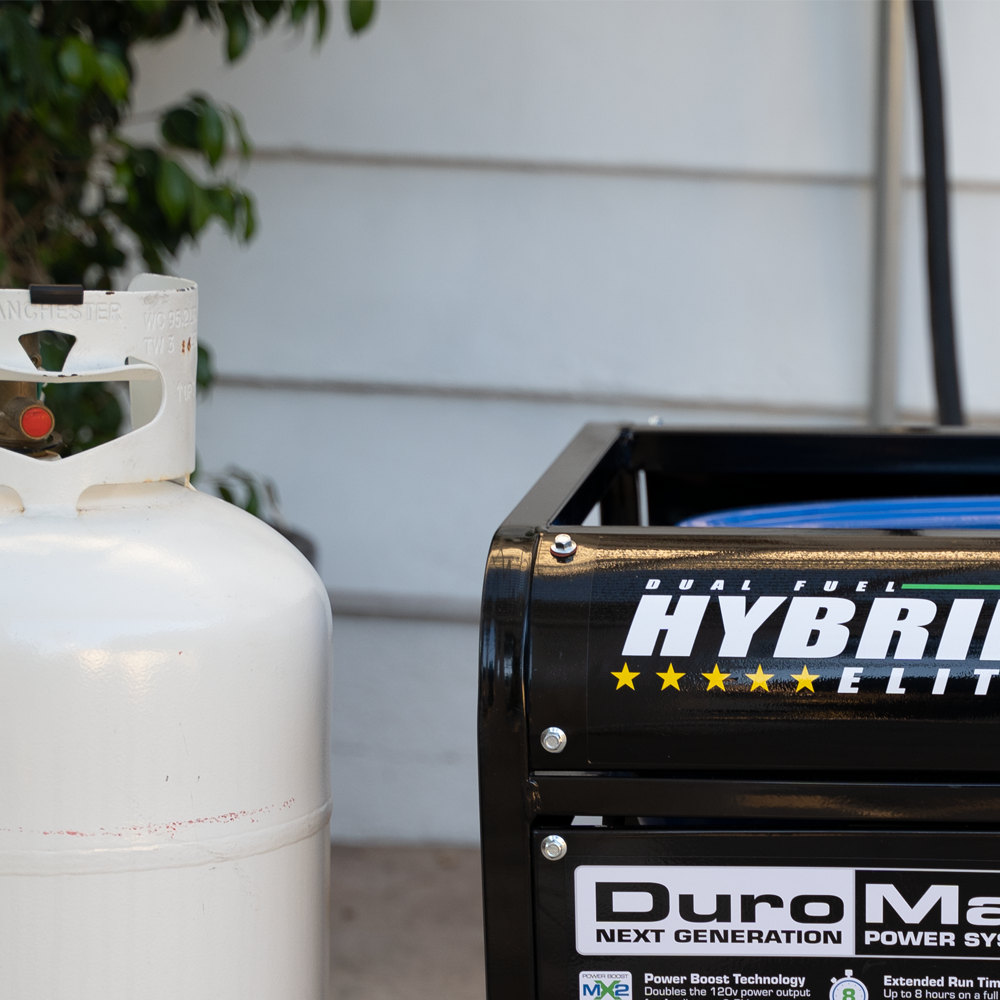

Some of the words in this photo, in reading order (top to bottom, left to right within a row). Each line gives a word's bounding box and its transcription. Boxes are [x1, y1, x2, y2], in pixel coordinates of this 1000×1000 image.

[645, 579, 753, 591] DUAL
[793, 580, 896, 592] FUEL
[595, 881, 844, 924] Duro
[596, 929, 665, 943] NEXT
[674, 929, 842, 944] GENERATION
[864, 930, 955, 946] POWER
[644, 973, 687, 984] Power
[690, 973, 730, 984] Boost
[732, 973, 806, 988] Technology
[884, 975, 944, 987] Extended
[948, 976, 974, 987] Run
[583, 980, 629, 1000] MX2
[644, 986, 687, 996] Doubles
[689, 987, 707, 996] the
[710, 987, 738, 996] 120v
[741, 989, 774, 998] power
[776, 989, 811, 999] output
[884, 989, 898, 1000] Up
[901, 990, 912, 998] to
[915, 989, 922, 998] 8
[925, 989, 956, 999] hours
[983, 990, 998, 1000] full
